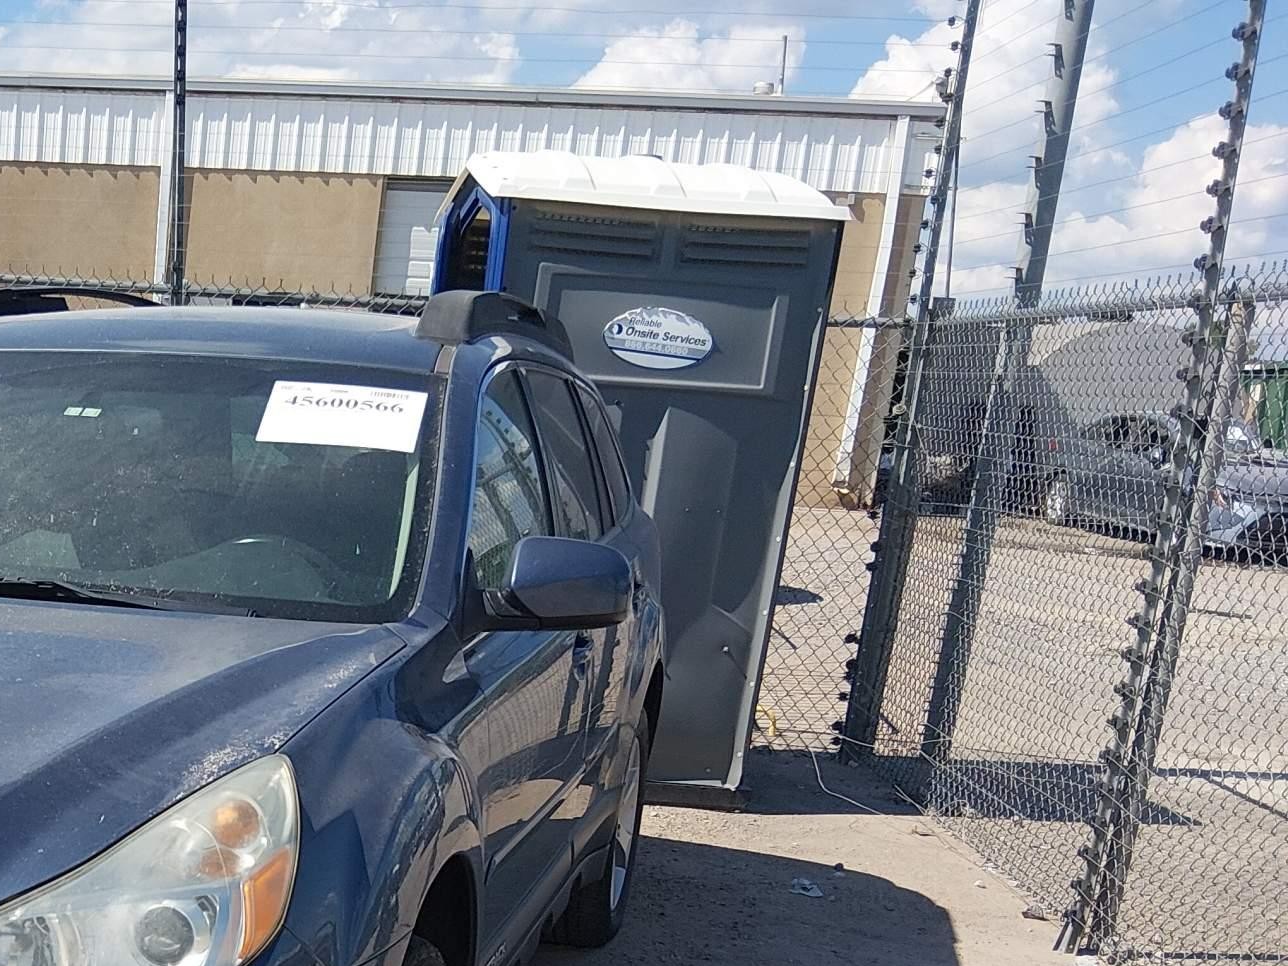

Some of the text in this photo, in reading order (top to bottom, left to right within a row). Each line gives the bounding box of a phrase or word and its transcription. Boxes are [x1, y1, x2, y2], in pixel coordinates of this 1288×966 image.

[629, 317, 663, 329] Reliable
[626, 327, 707, 347] Onsite Services
[284, 395, 404, 414] 45600566
